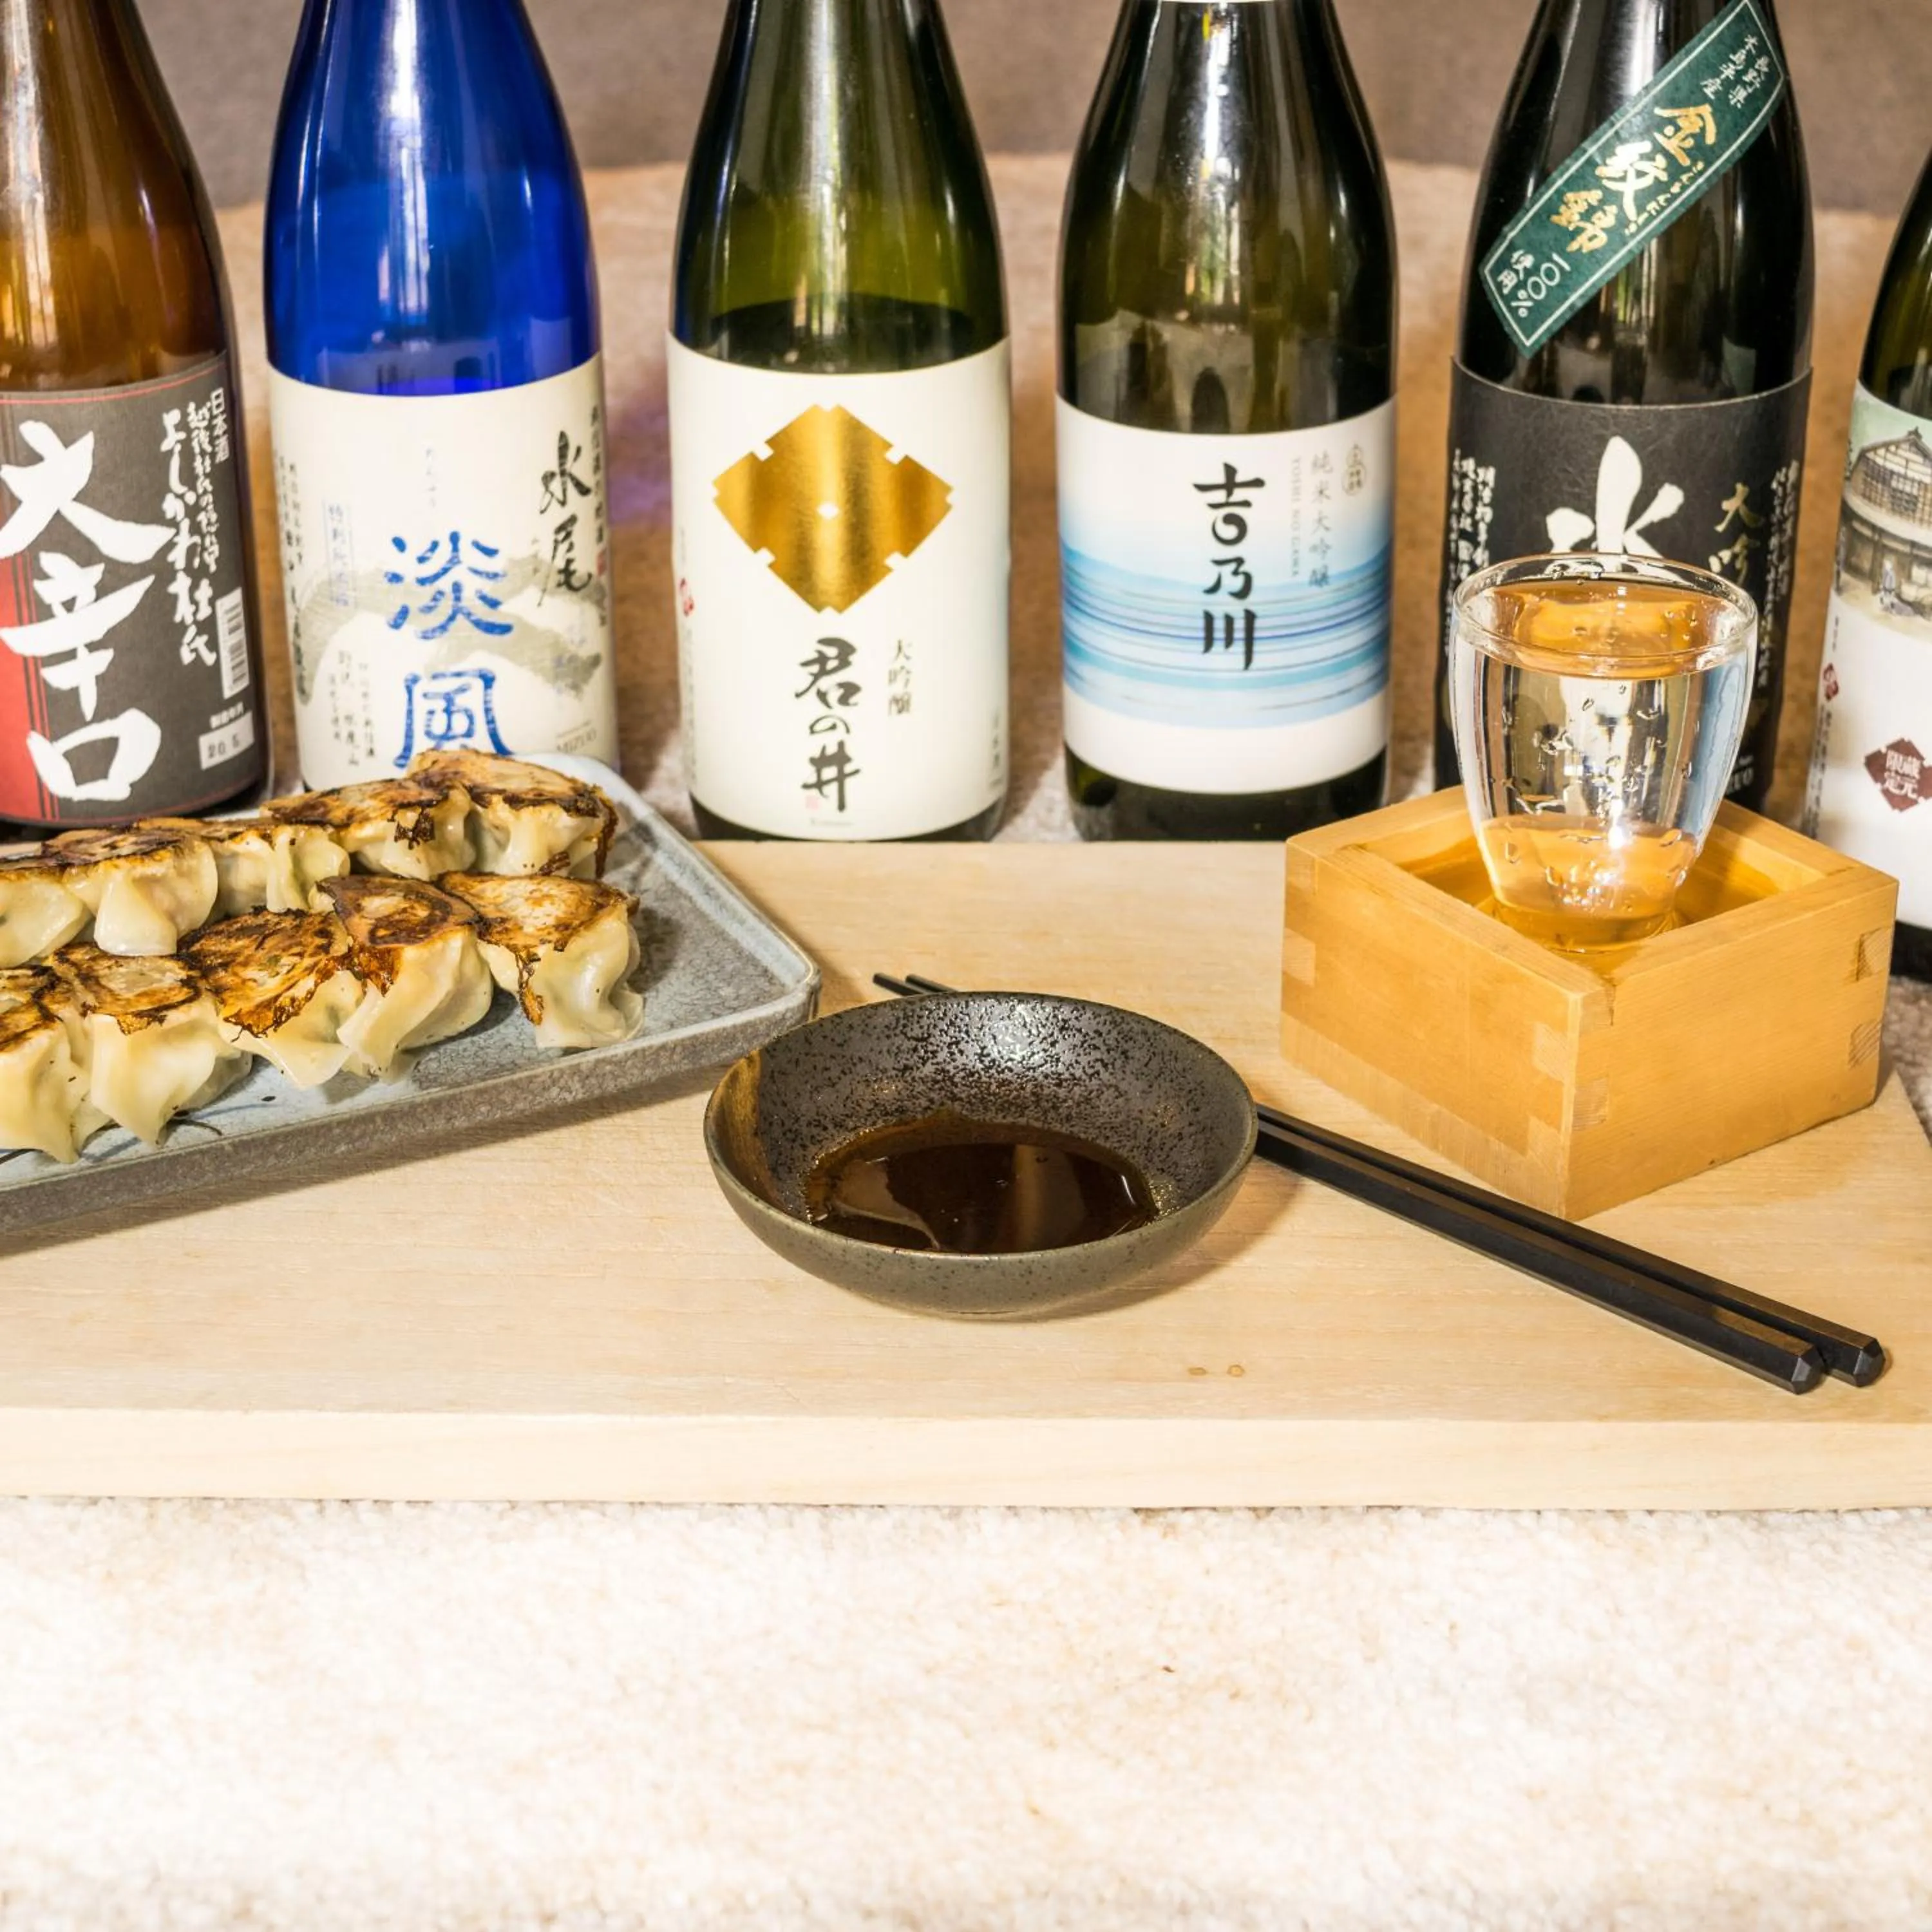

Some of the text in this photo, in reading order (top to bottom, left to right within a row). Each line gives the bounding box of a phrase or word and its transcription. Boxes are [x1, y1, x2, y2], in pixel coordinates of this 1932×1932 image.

[1549, 103, 1716, 254] 金紋錦
[1496, 249, 1535, 296] 使用
[210, 387, 229, 464] 日本酒
[160, 408, 216, 666] よしかわ杜氏
[537, 431, 592, 607] 水尾
[1192, 462, 1266, 671] 吉乃川
[1309, 450, 1334, 588] 純米大吟醸
[0, 420, 176, 802] 大辛口
[385, 531, 514, 768] 淡風
[887, 638, 913, 716] 大吟醸
[794, 636, 862, 813] 君の井
